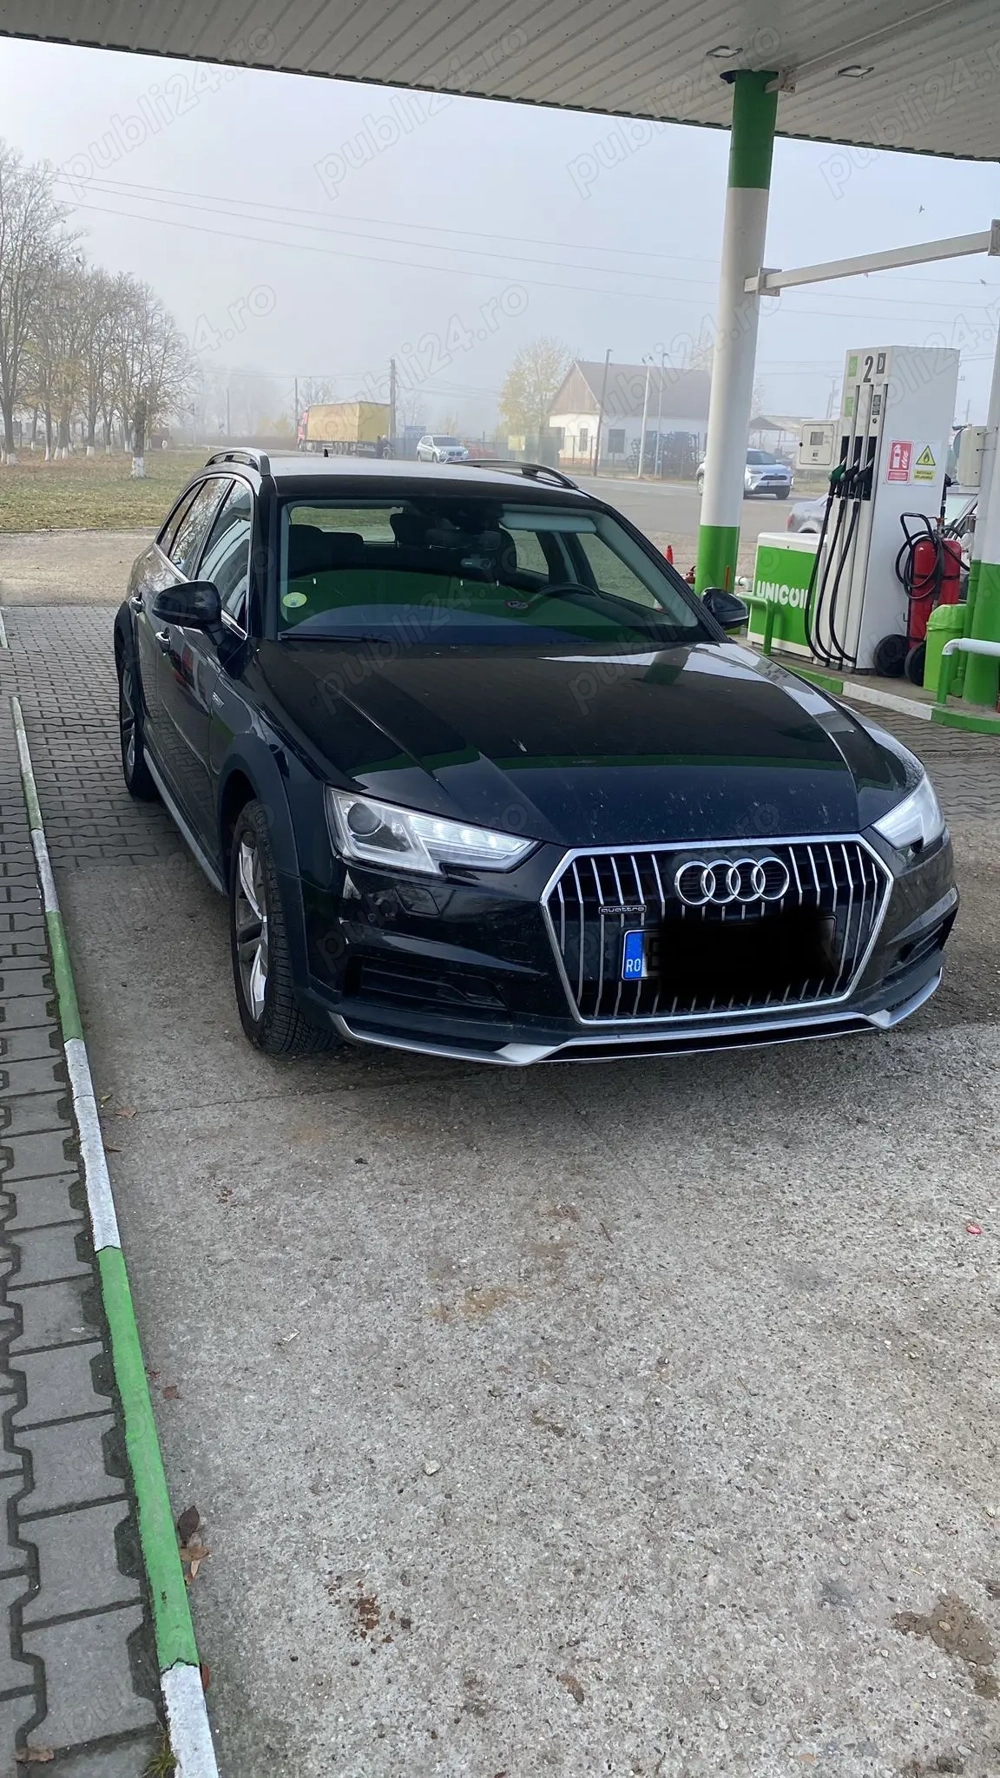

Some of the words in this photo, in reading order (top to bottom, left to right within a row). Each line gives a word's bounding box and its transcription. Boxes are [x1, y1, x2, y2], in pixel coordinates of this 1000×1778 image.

[863, 355, 874, 383] 2
[600, 905, 645, 913] quattro
[626, 958, 641, 973] RO
